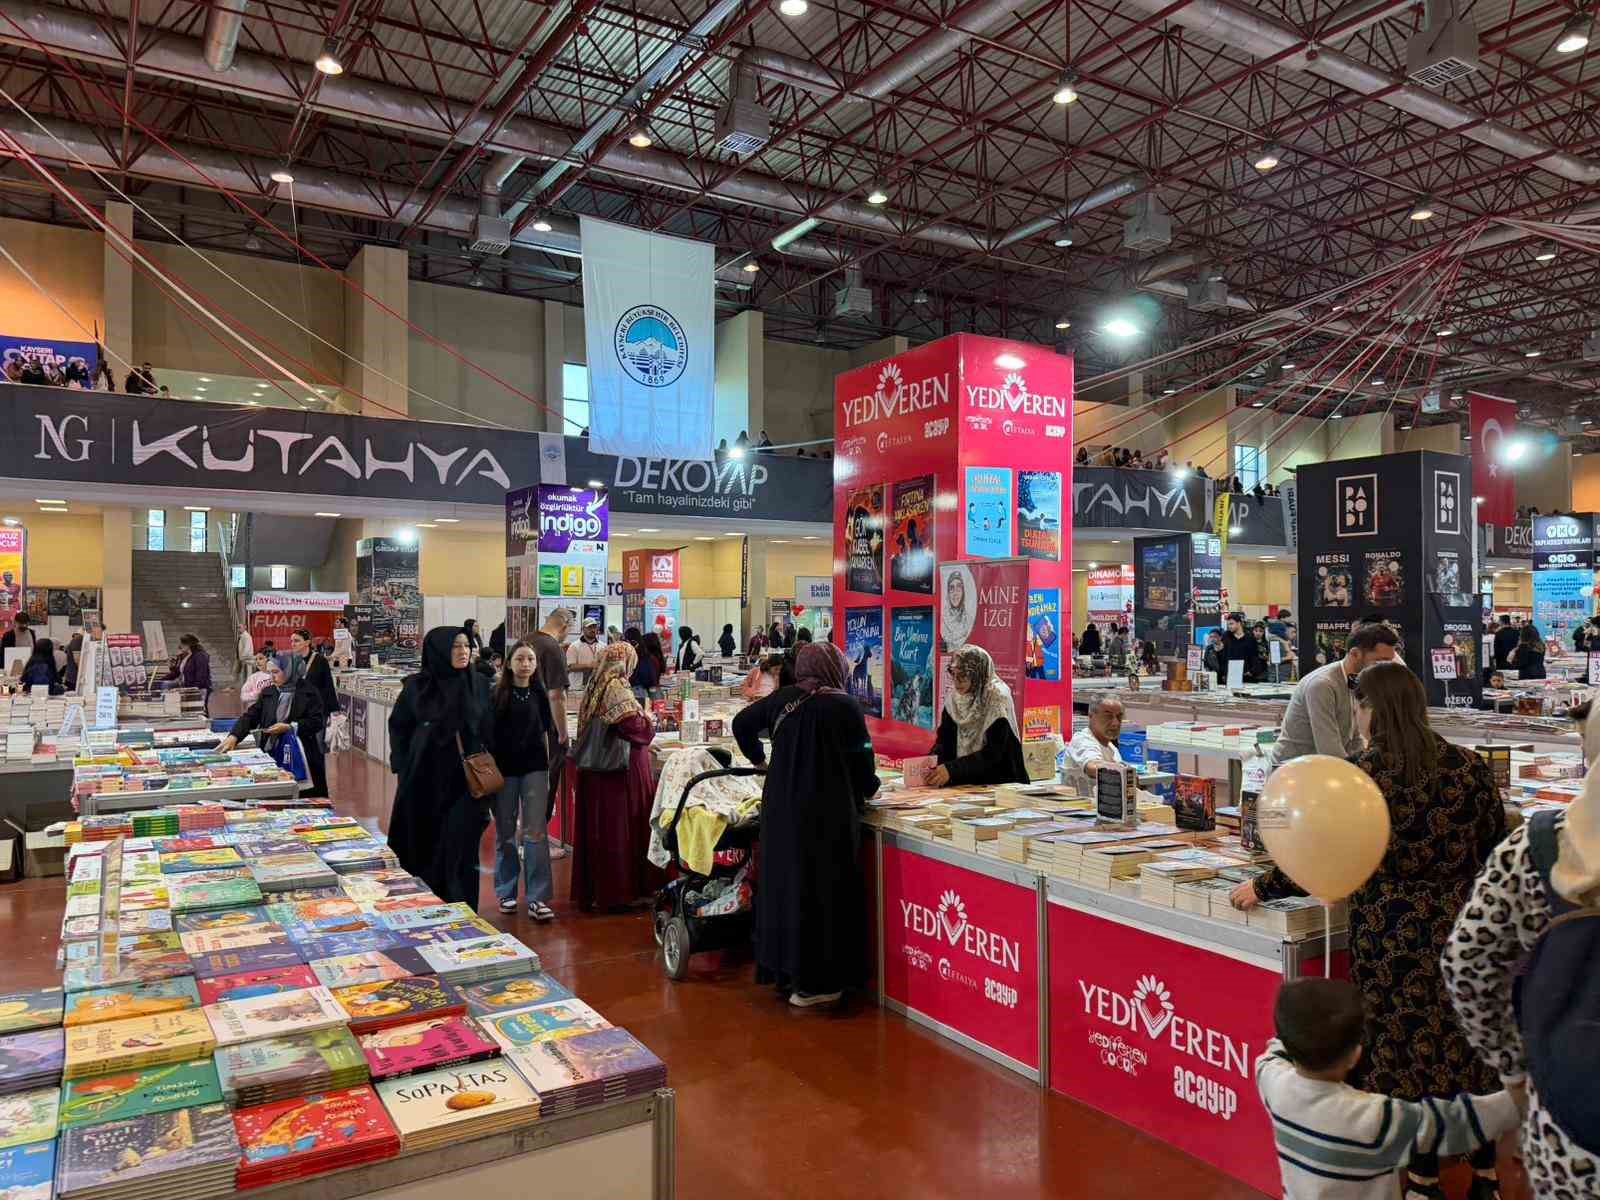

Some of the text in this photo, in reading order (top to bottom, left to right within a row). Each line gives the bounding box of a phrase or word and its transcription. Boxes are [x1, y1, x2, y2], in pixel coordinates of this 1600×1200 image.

[642, 374, 665, 385] 1869
[613, 456, 769, 496] DEKOYAP
[547, 493, 578, 503] okumak
[657, 493, 731, 509] hayalinizdeki
[540, 512, 600, 538] indigo
[978, 586, 1020, 605] MİNE
[983, 608, 1012, 627] İZGİ
[1173, 1064, 1238, 1121] acayip
